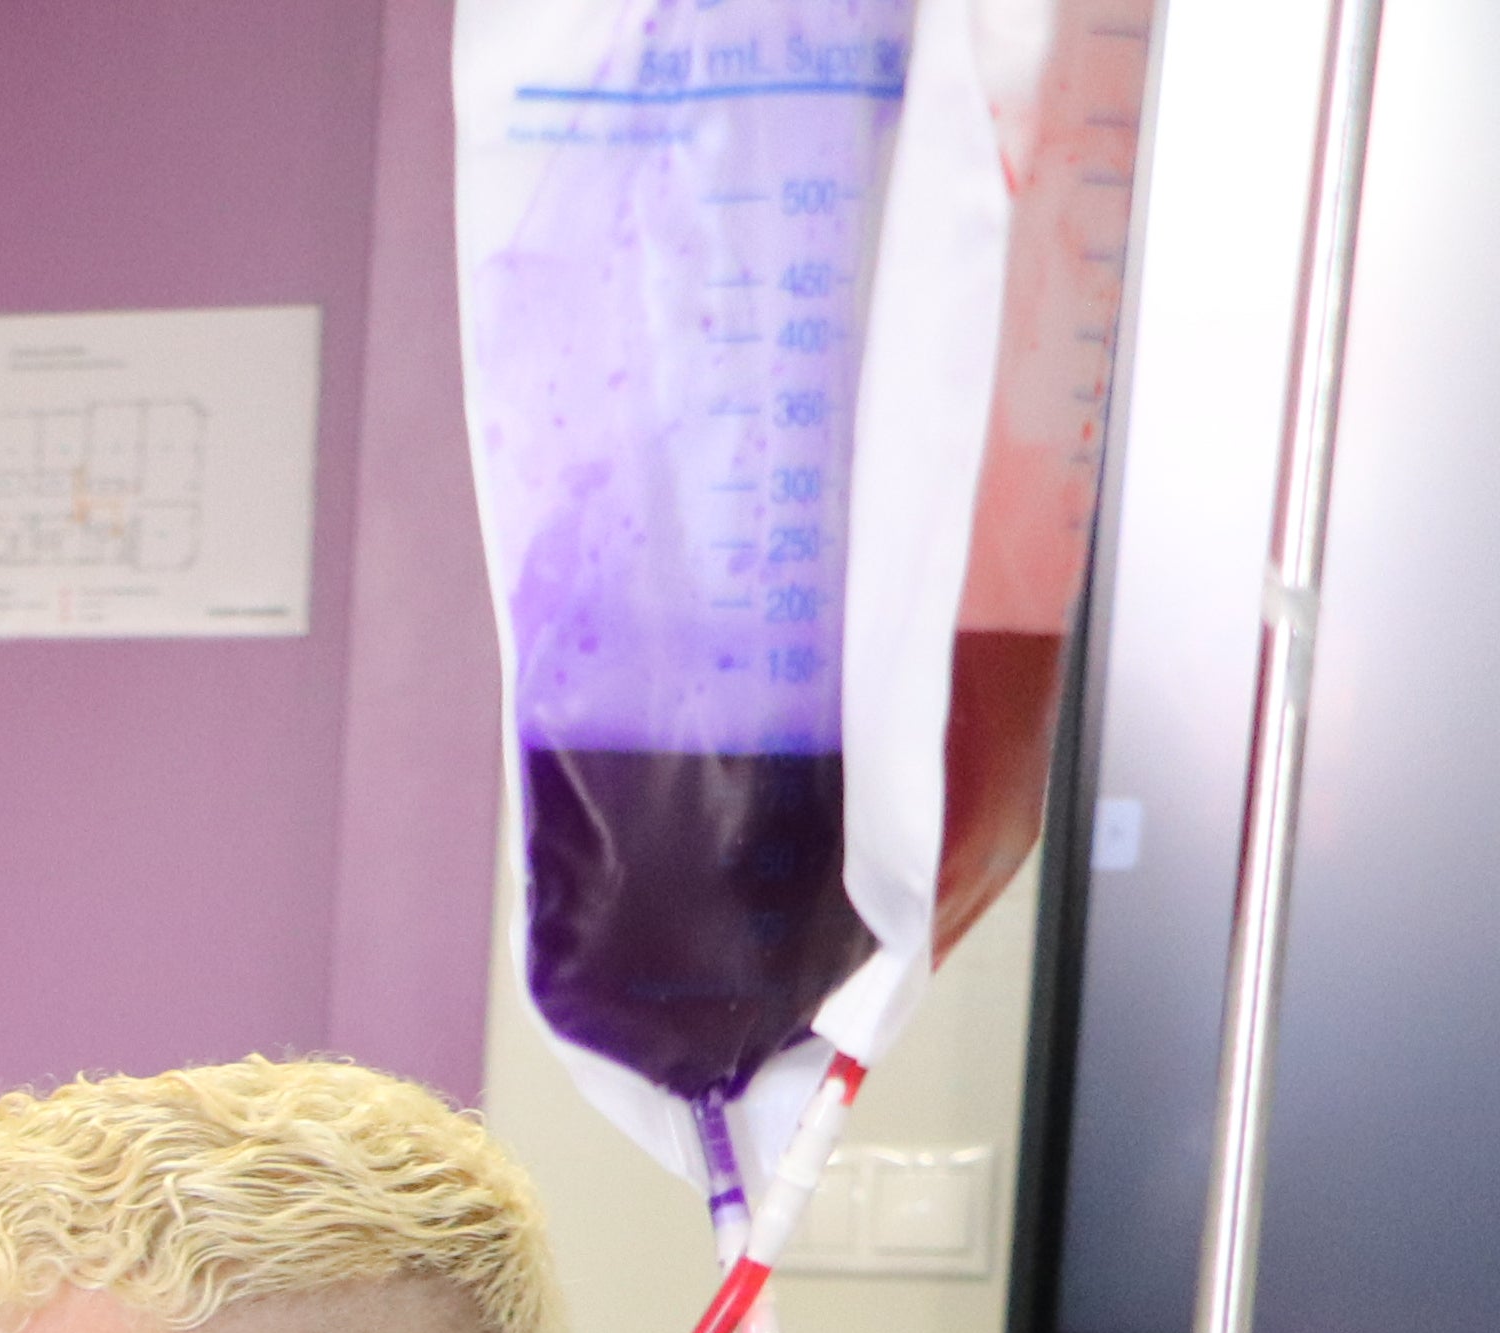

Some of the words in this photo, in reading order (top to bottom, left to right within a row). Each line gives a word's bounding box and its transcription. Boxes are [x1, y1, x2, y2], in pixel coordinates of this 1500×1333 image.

[782, 179, 837, 216] 500
[779, 262, 834, 298] 450
[778, 319, 831, 354] 400
[771, 467, 820, 504] 300
[768, 526, 820, 563] 250
[765, 586, 819, 624] 200
[767, 647, 816, 684] 150
